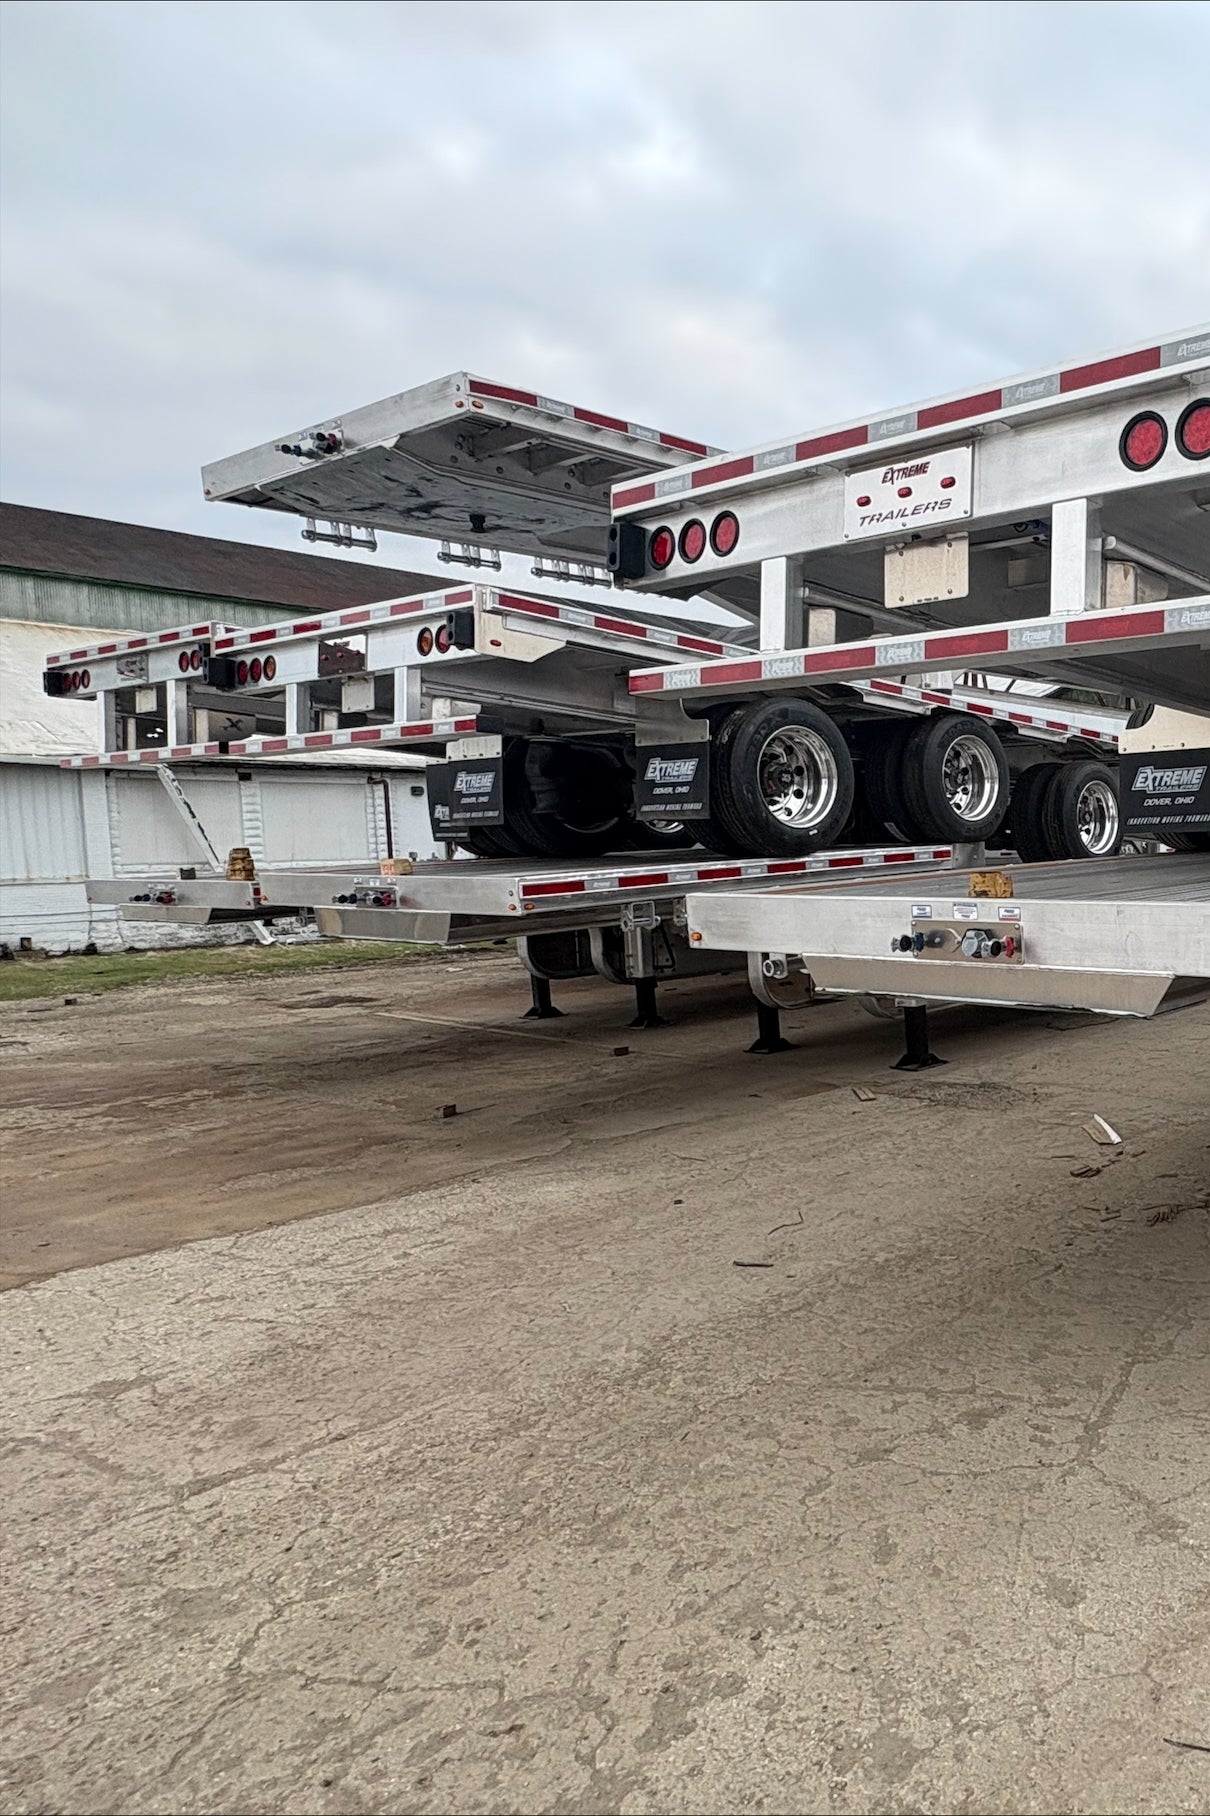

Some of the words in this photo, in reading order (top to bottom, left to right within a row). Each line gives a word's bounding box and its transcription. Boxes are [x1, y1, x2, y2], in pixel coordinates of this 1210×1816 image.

[881, 461, 931, 485] EXTREME
[859, 498, 952, 527] TRAILERS
[648, 760, 696, 780] EXTREME
[1136, 769, 1203, 791] EXTREME
[1174, 796, 1195, 805] OHIO
